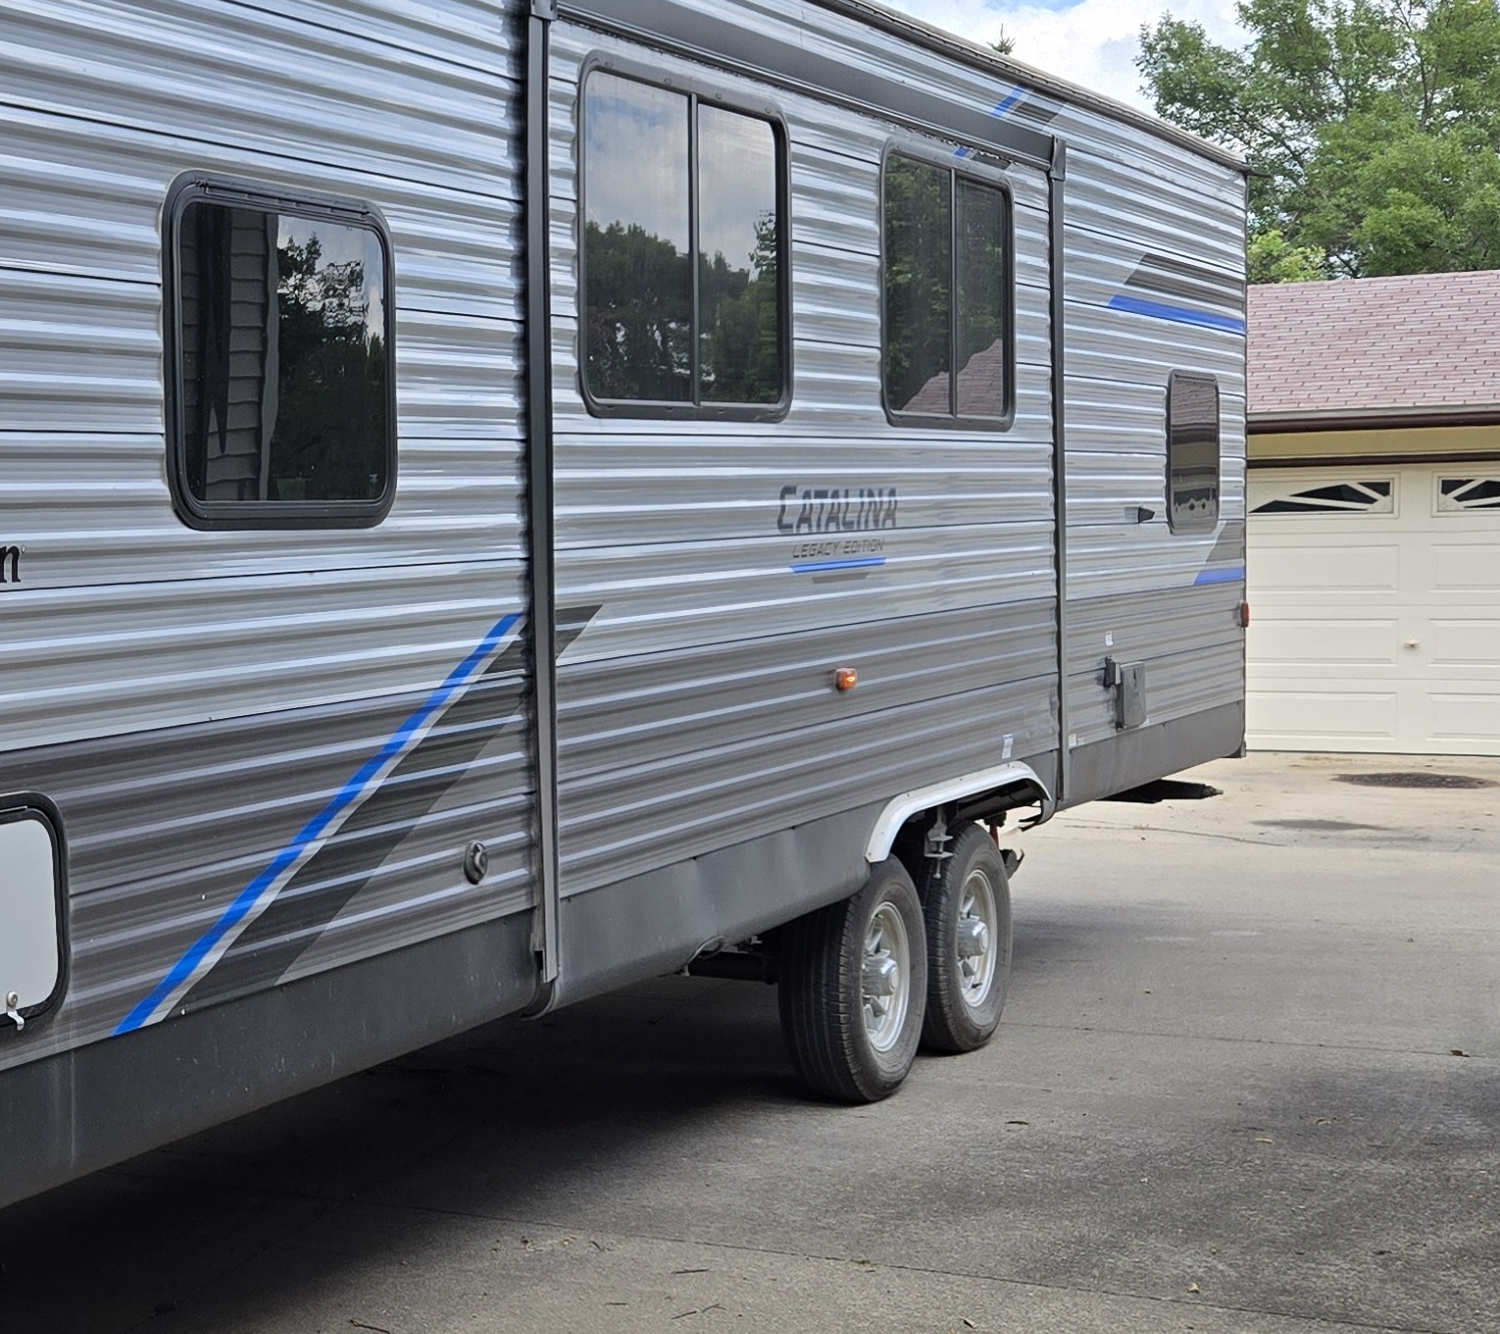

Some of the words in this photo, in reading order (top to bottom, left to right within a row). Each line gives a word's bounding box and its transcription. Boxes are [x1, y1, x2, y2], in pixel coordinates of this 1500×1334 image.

[778, 485, 898, 534] CATALINA
[792, 541, 839, 559] LEGACY
[843, 538, 885, 554] EDITION
